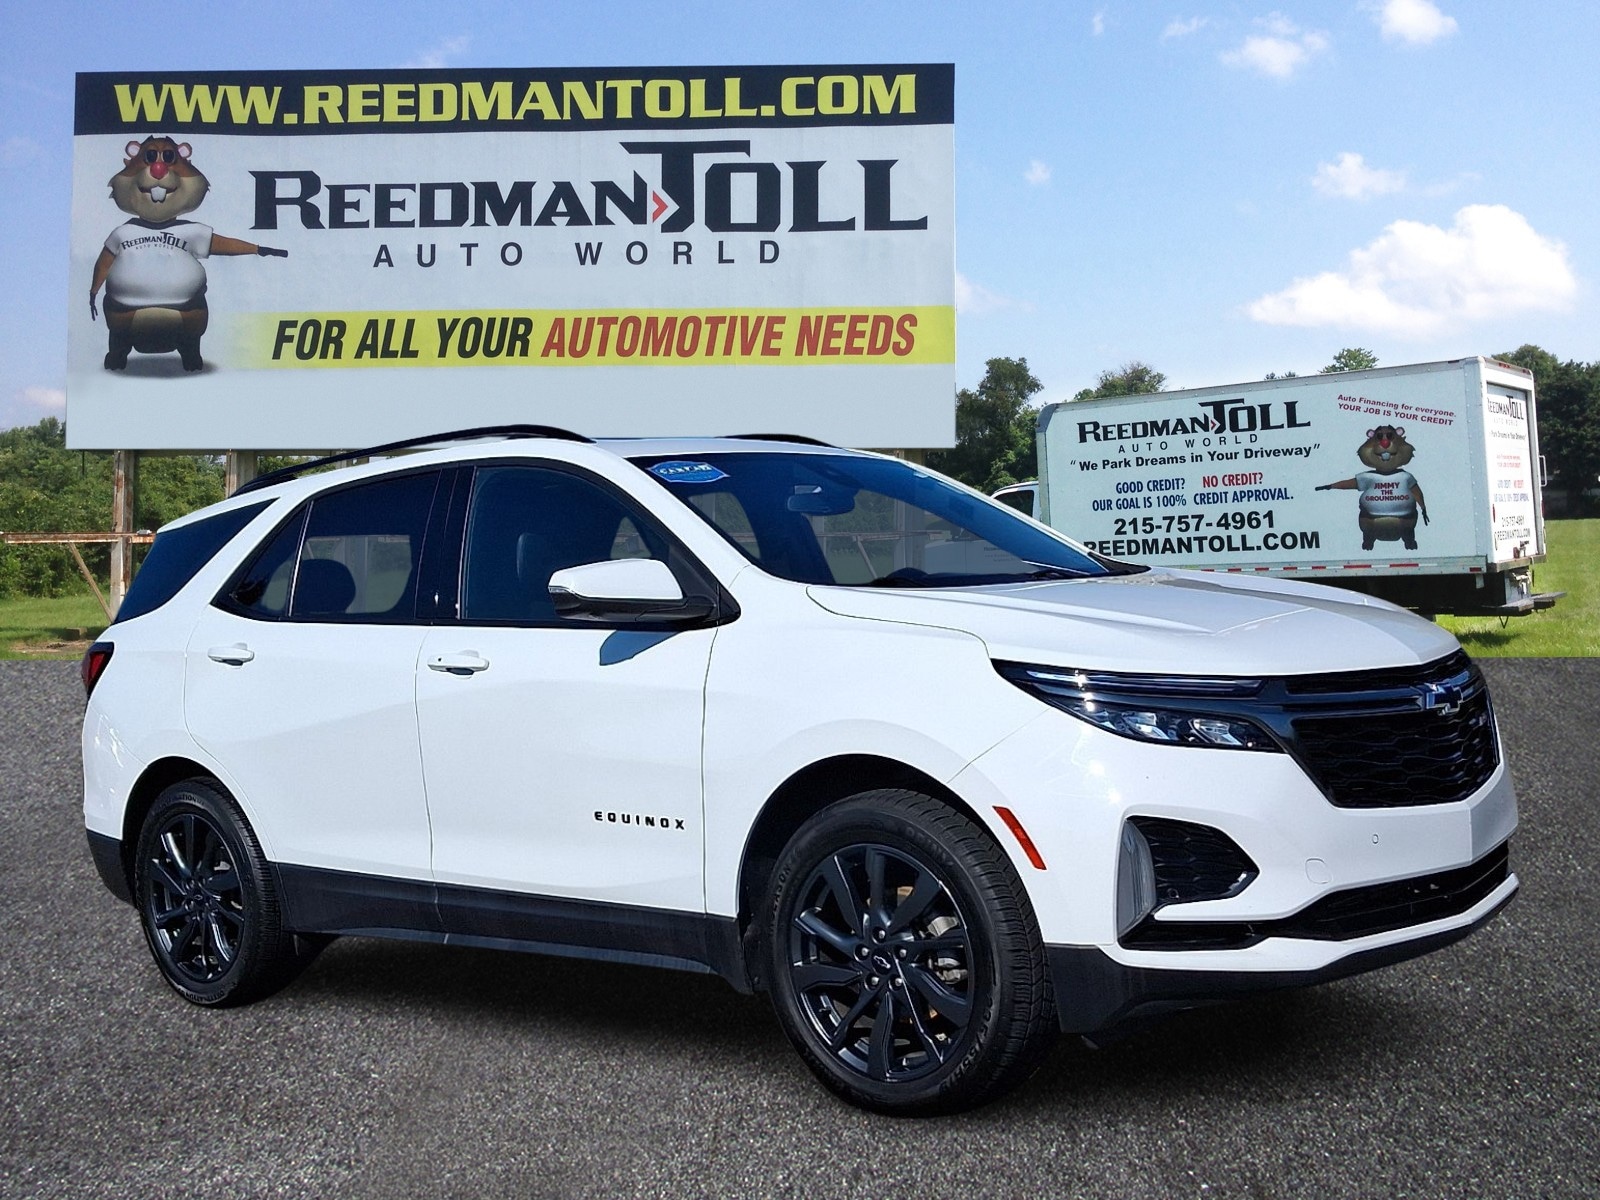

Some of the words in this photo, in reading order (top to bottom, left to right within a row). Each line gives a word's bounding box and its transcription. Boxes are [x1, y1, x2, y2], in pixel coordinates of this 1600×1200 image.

[114, 73, 917, 125] WWW.REEDMANTOLL.COM
[373, 242, 523, 268] AUTO
[575, 240, 780, 266] WORLD
[271, 319, 347, 360] FOR
[354, 319, 419, 360] ALL
[437, 316, 533, 359] YOUR
[541, 315, 784, 358] AUTOMOTIVE
[795, 313, 918, 357] NEEDS
[1338, 394, 1357, 403] Auto
[1359, 397, 1399, 410] Financing
[1401, 403, 1413, 411] for
[1415, 405, 1457, 418] everyone.
[1338, 403, 1361, 412] YOUR
[1363, 407, 1381, 415] JOB
[1383, 409, 1392, 417] IS
[1394, 411, 1418, 421] YOUR
[1420, 415, 1454, 426] CREDIT
[1118, 441, 1168, 454] AUTO
[1185, 433, 1258, 448] WORLD
[1102, 457, 1131, 469] Park
[1135, 453, 1186, 467] Dreams
[1190, 452, 1203, 462] in
[1207, 450, 1240, 461] Your
[1116, 480, 1143, 494] GOOD
[1146, 477, 1185, 492] CREDIT?
[1202, 475, 1218, 488] NO
[1222, 472, 1263, 487] CREDIT?
[1092, 499, 1113, 512] OUR
[1116, 497, 1140, 510] GOAL
[1143, 496, 1152, 508] IS
[1157, 494, 1187, 508] 100%
[1193, 491, 1228, 506] CREDIT
[1232, 487, 1294, 504] APPROVAL.
[1113, 510, 1274, 536] 215-757-4961
[594, 811, 684, 830] EQUINOX
